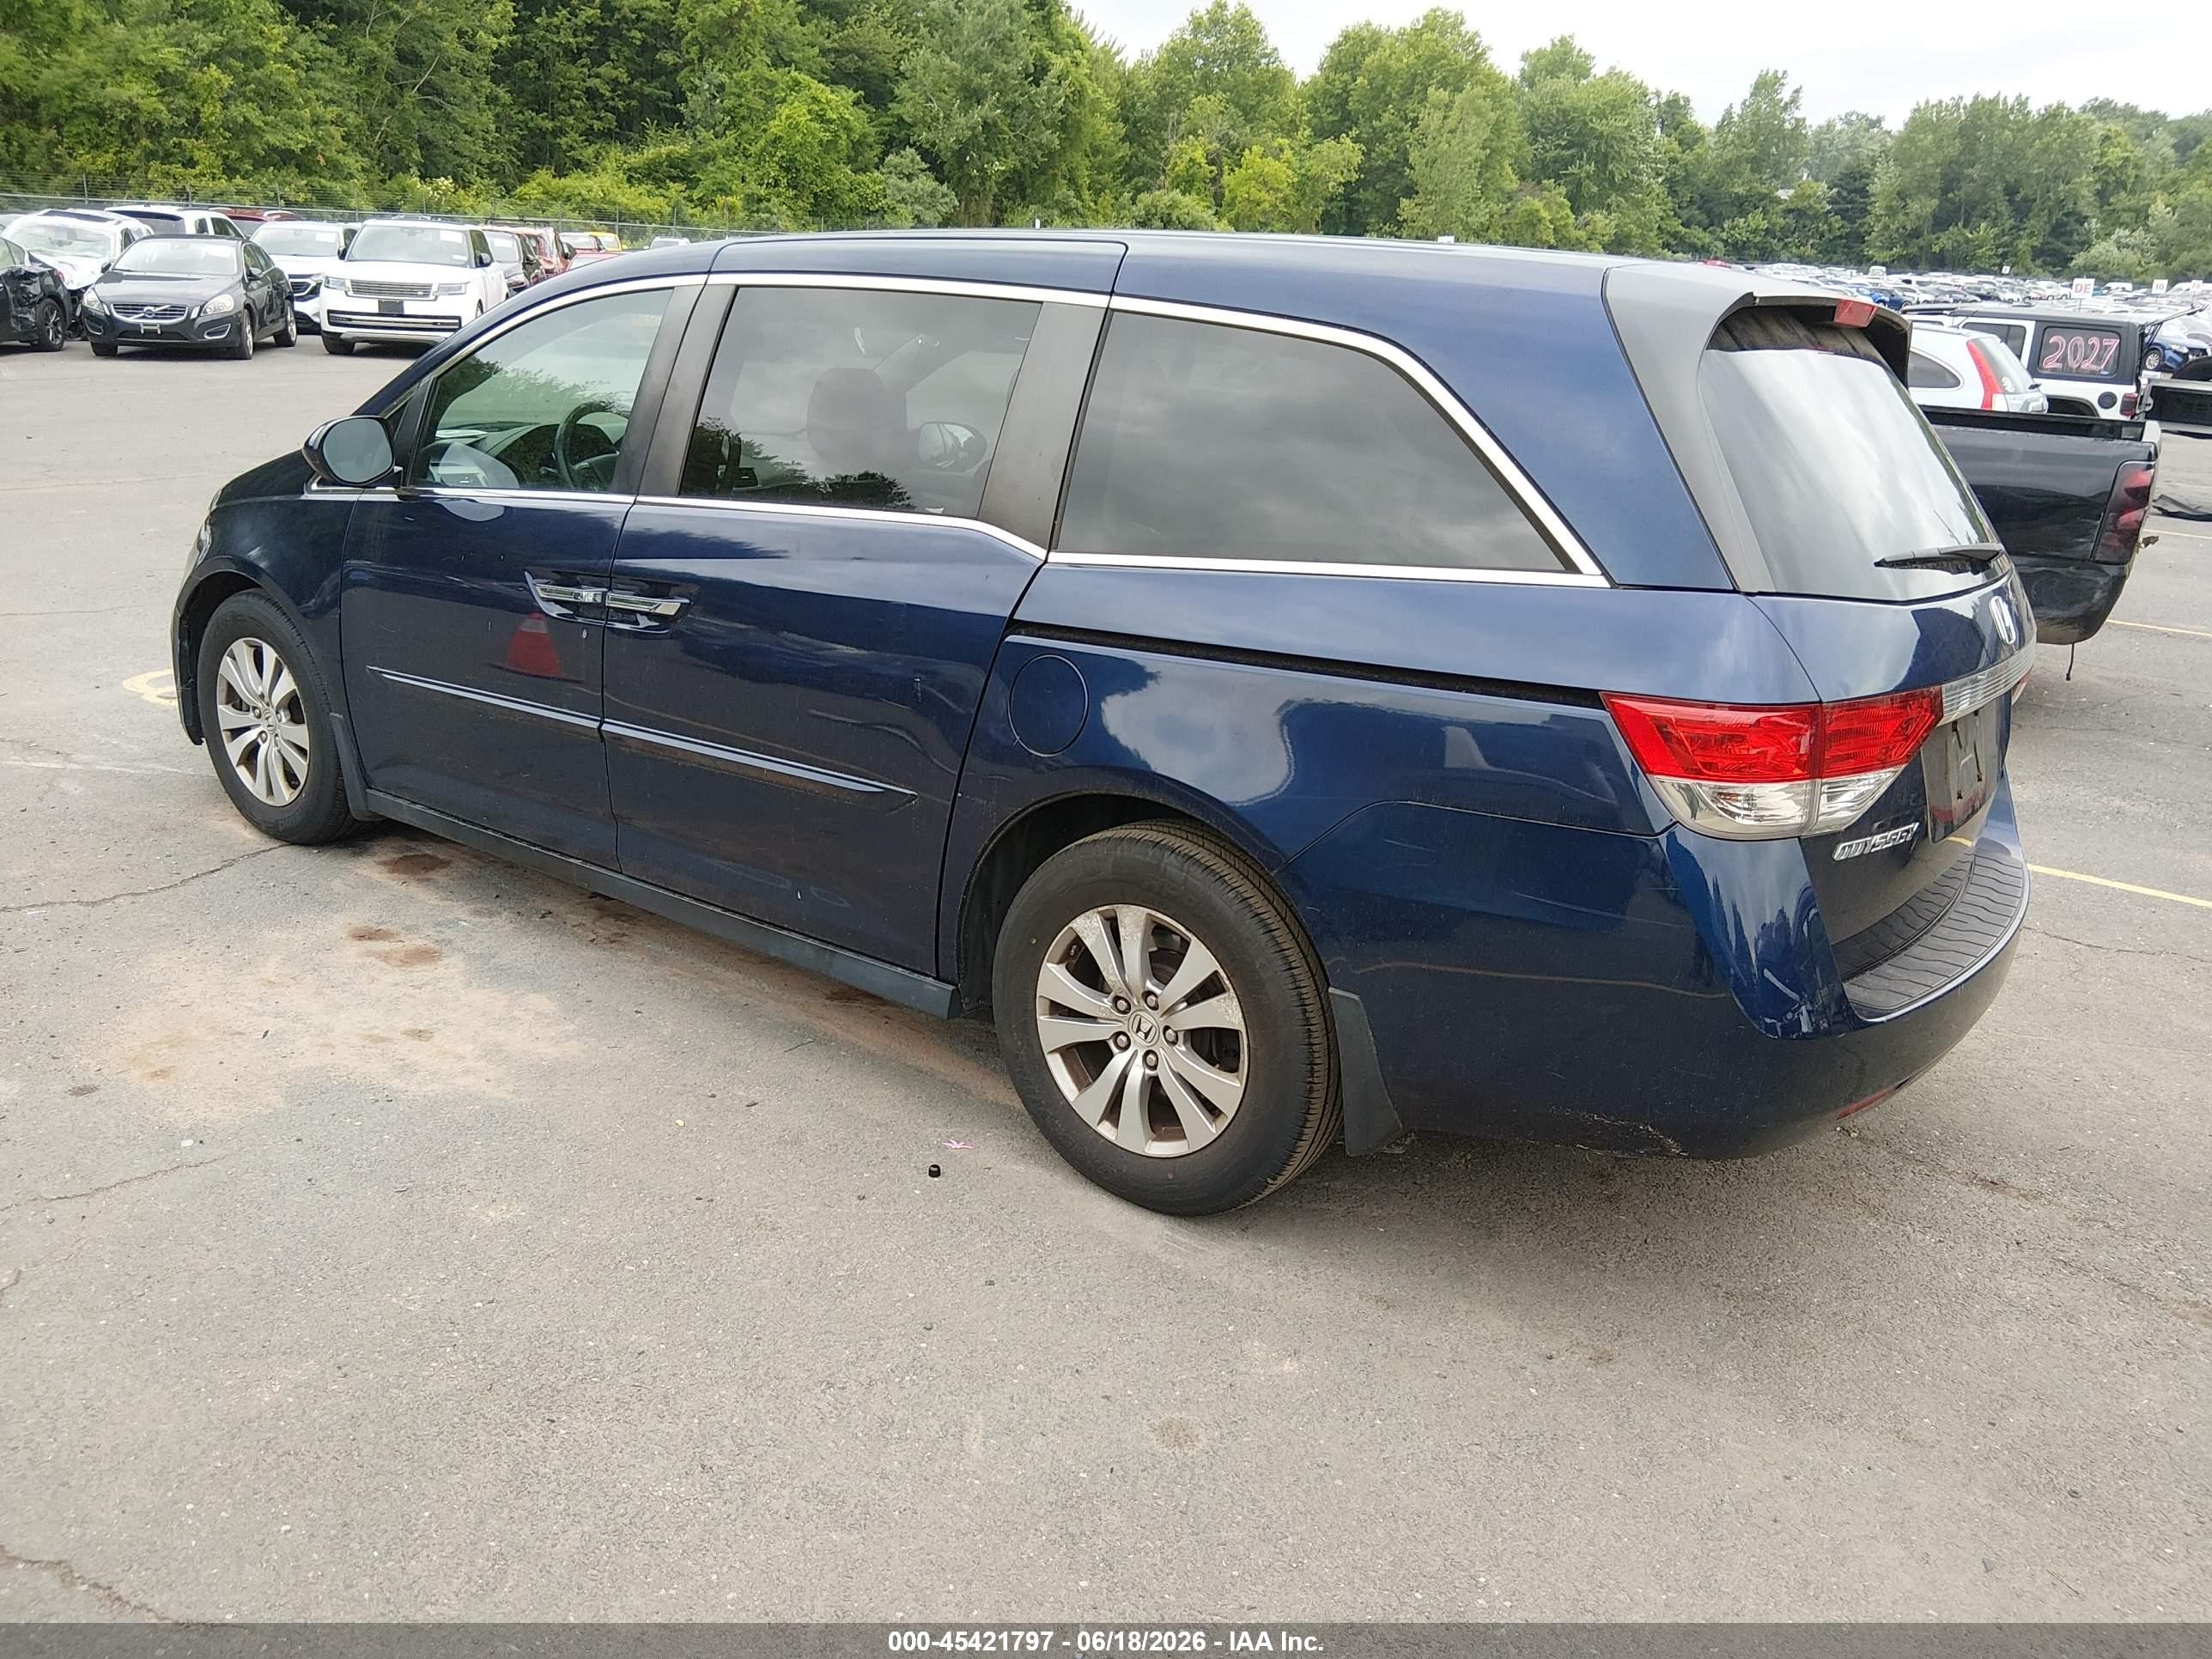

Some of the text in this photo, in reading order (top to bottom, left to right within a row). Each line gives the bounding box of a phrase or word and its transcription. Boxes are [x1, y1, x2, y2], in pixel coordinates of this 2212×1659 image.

[2074, 283, 2092, 295] DE
[2043, 335, 2120, 371] 2027
[1832, 822, 1920, 861] ODYSSEY
